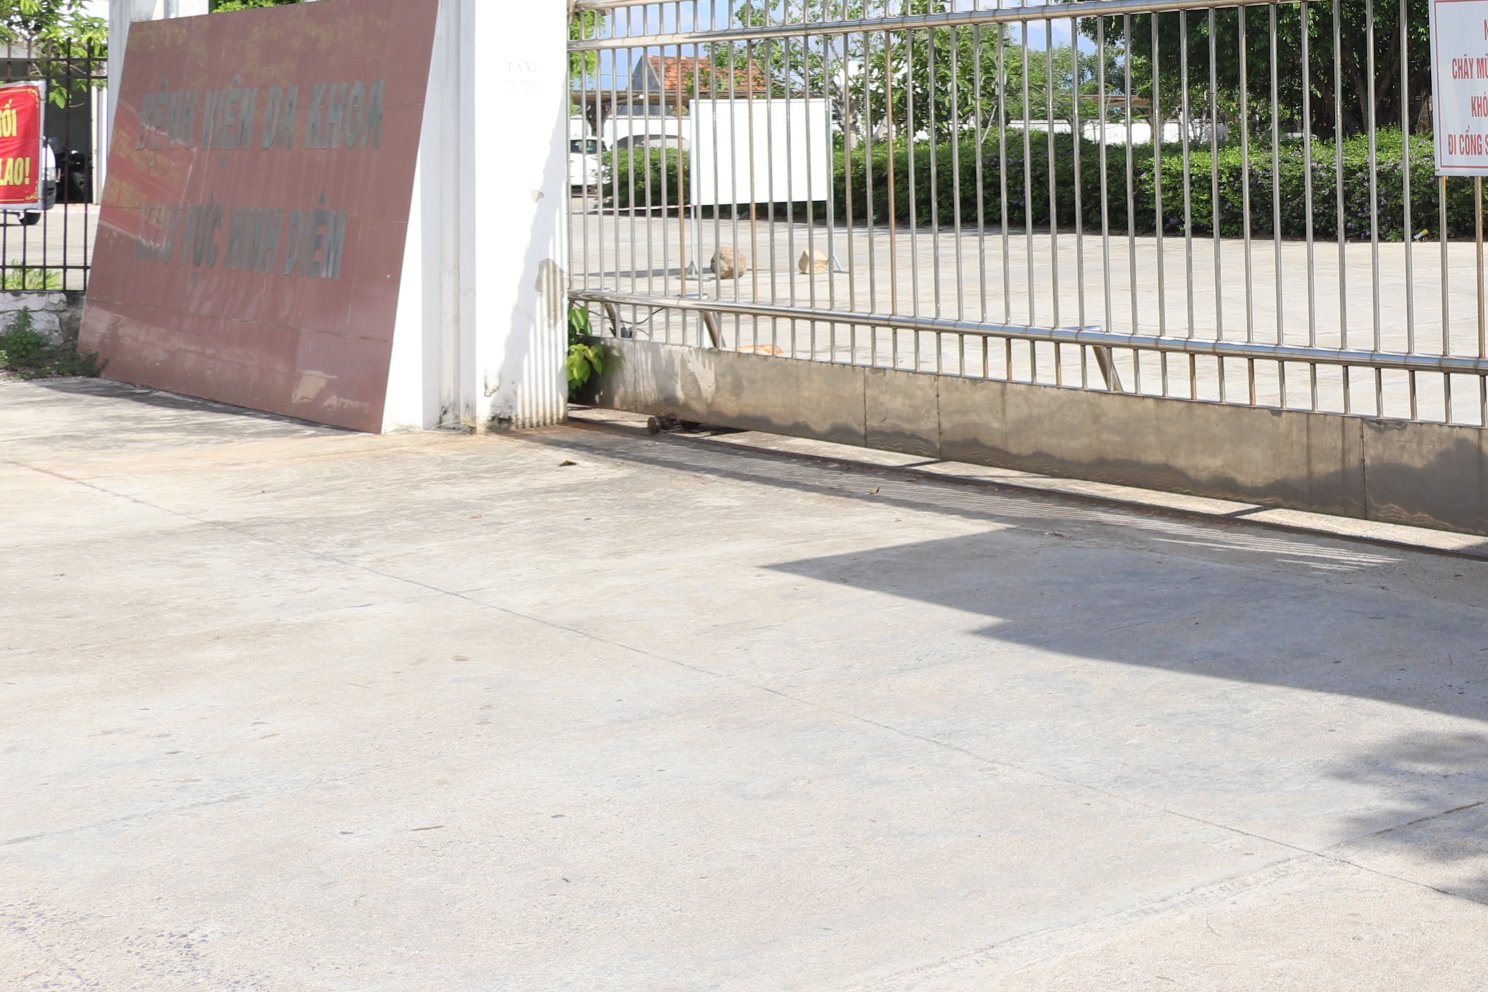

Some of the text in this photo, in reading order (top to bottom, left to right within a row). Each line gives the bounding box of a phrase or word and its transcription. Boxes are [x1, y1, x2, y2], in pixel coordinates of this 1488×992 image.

[303, 79, 385, 150] KHOA
[1470, 91, 1488, 117] KHÓ
[1448, 134, 1456, 155] ĐI
[1459, 125, 1482, 156] CỔNG
